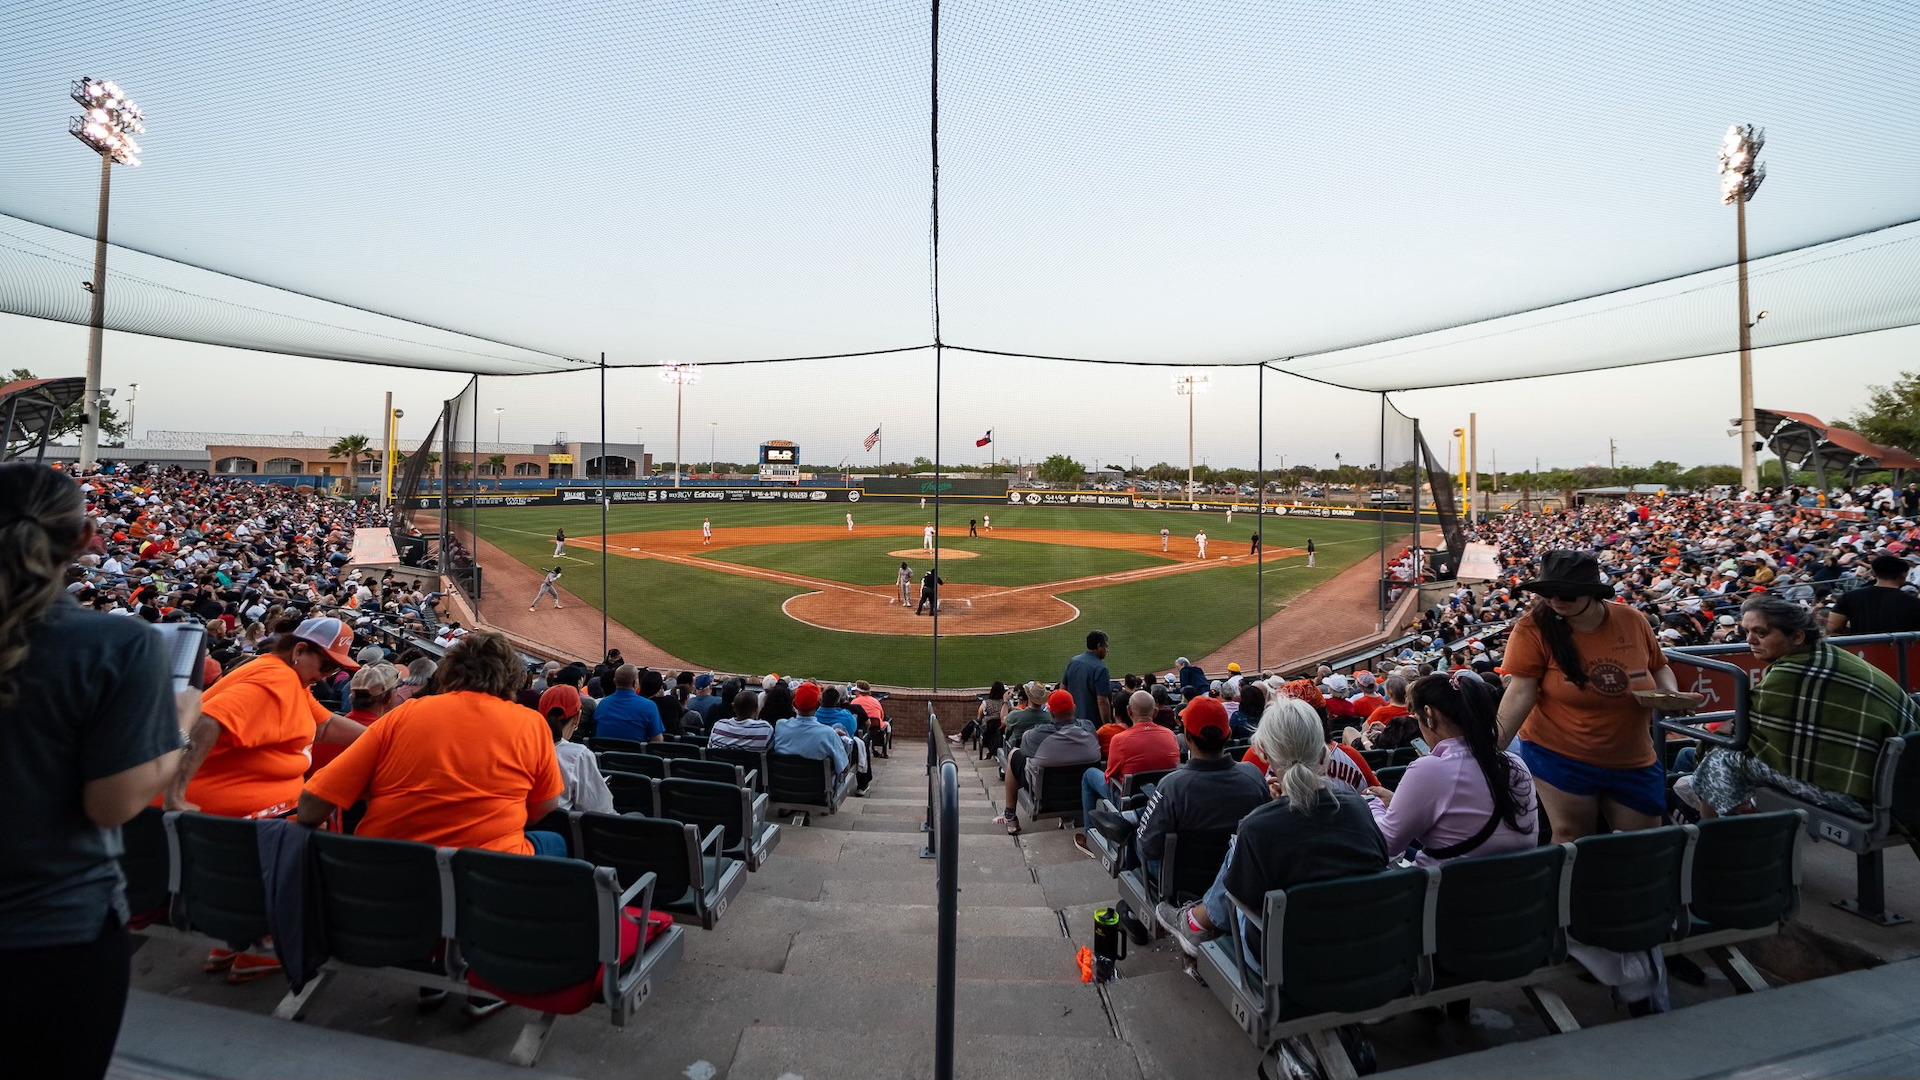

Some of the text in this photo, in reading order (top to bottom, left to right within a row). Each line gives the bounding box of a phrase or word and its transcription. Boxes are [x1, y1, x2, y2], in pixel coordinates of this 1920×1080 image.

[694, 491, 724, 500] Edinburg
[1105, 496, 1129, 504] Driscoll
[1602, 673, 1617, 684] H
[1826, 826, 1842, 839] 14
[636, 984, 648, 1002] 14
[1235, 1004, 1245, 1023] 14
